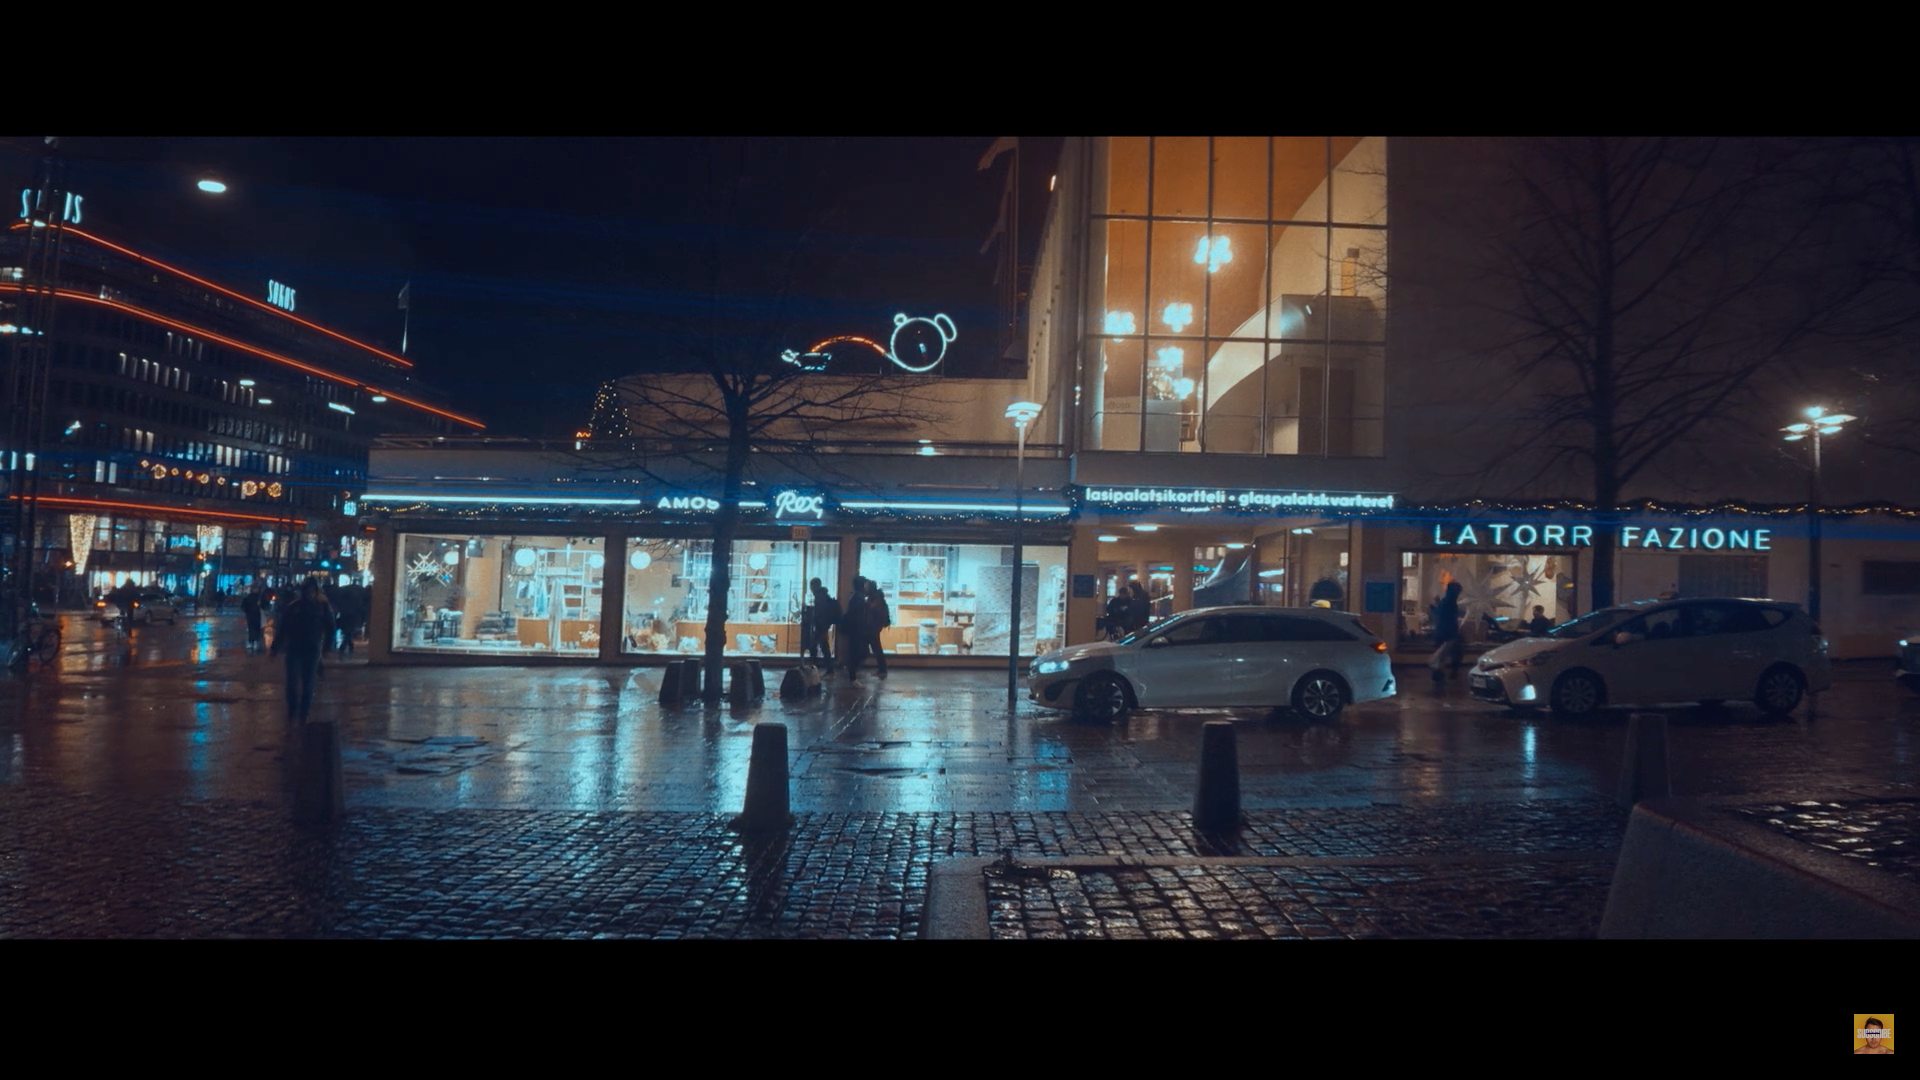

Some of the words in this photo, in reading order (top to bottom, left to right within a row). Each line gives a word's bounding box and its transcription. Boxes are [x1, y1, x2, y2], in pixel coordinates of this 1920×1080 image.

[267, 279, 296, 312] SOKOS
[776, 491, 823, 519] Rex
[1086, 487, 1226, 503] lasipalatsikortteli
[1239, 491, 1394, 508] glaspalatskvarteret
